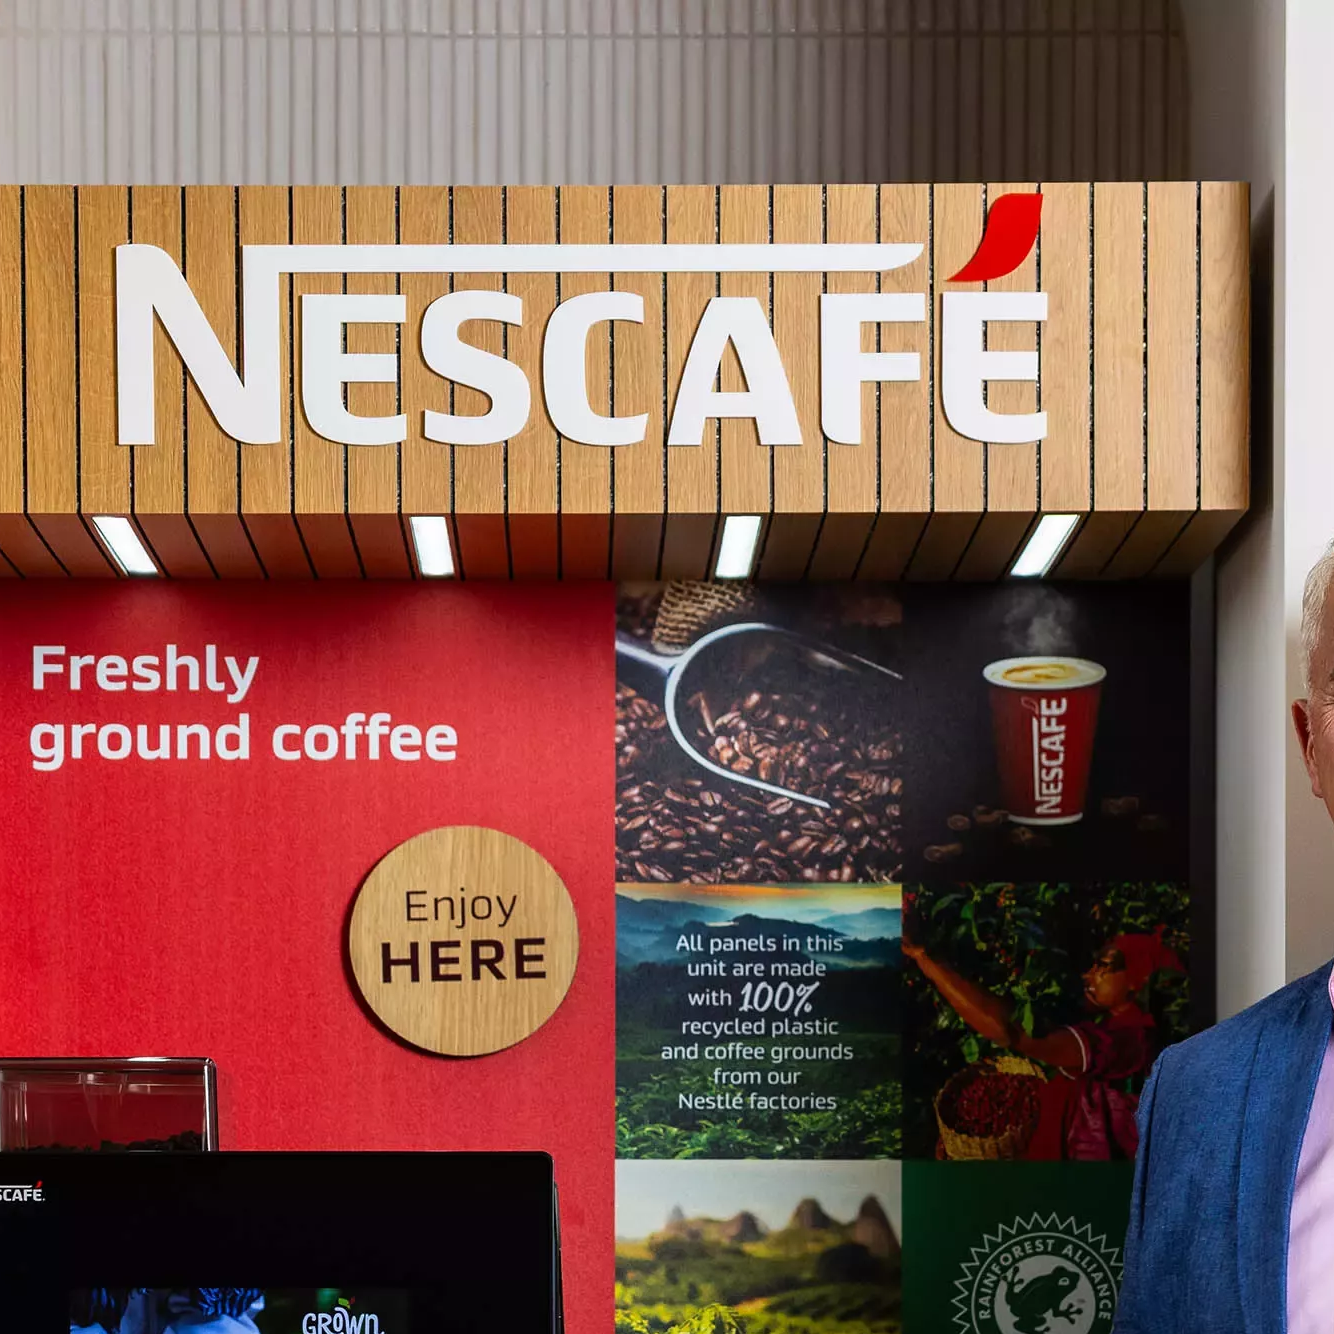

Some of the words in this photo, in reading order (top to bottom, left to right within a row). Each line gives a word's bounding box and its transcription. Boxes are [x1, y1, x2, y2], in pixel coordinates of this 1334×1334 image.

[116, 194, 1048, 446] NESCAFÉ
[32, 644, 260, 703] Freshly
[30, 713, 250, 771] ground
[272, 712, 458, 761] coffee
[406, 887, 517, 929] Enjoy
[381, 937, 547, 984] HERE
[676, 934, 704, 952] All
[710, 934, 777, 955] panels
[782, 934, 800, 952] in
[806, 934, 843, 952] this
[687, 959, 727, 977] unit
[732, 962, 765, 977] are
[771, 959, 827, 977] made
[688, 988, 732, 1006] with
[738, 981, 820, 1017] 100%
[682, 1017, 766, 1039] recycled
[771, 1017, 839, 1038] plastic
[661, 1042, 699, 1060] and
[704, 1042, 765, 1060] coffee
[771, 1042, 854, 1063] grounds
[713, 1067, 761, 1085] from
[767, 1069, 802, 1085] our
[678, 1092, 743, 1110] Nestlé
[750, 1092, 837, 1110] factories
[978, 1240, 1055, 1320] RAINFOREST
[1062, 1244, 1112, 1321] ALLIANCE
